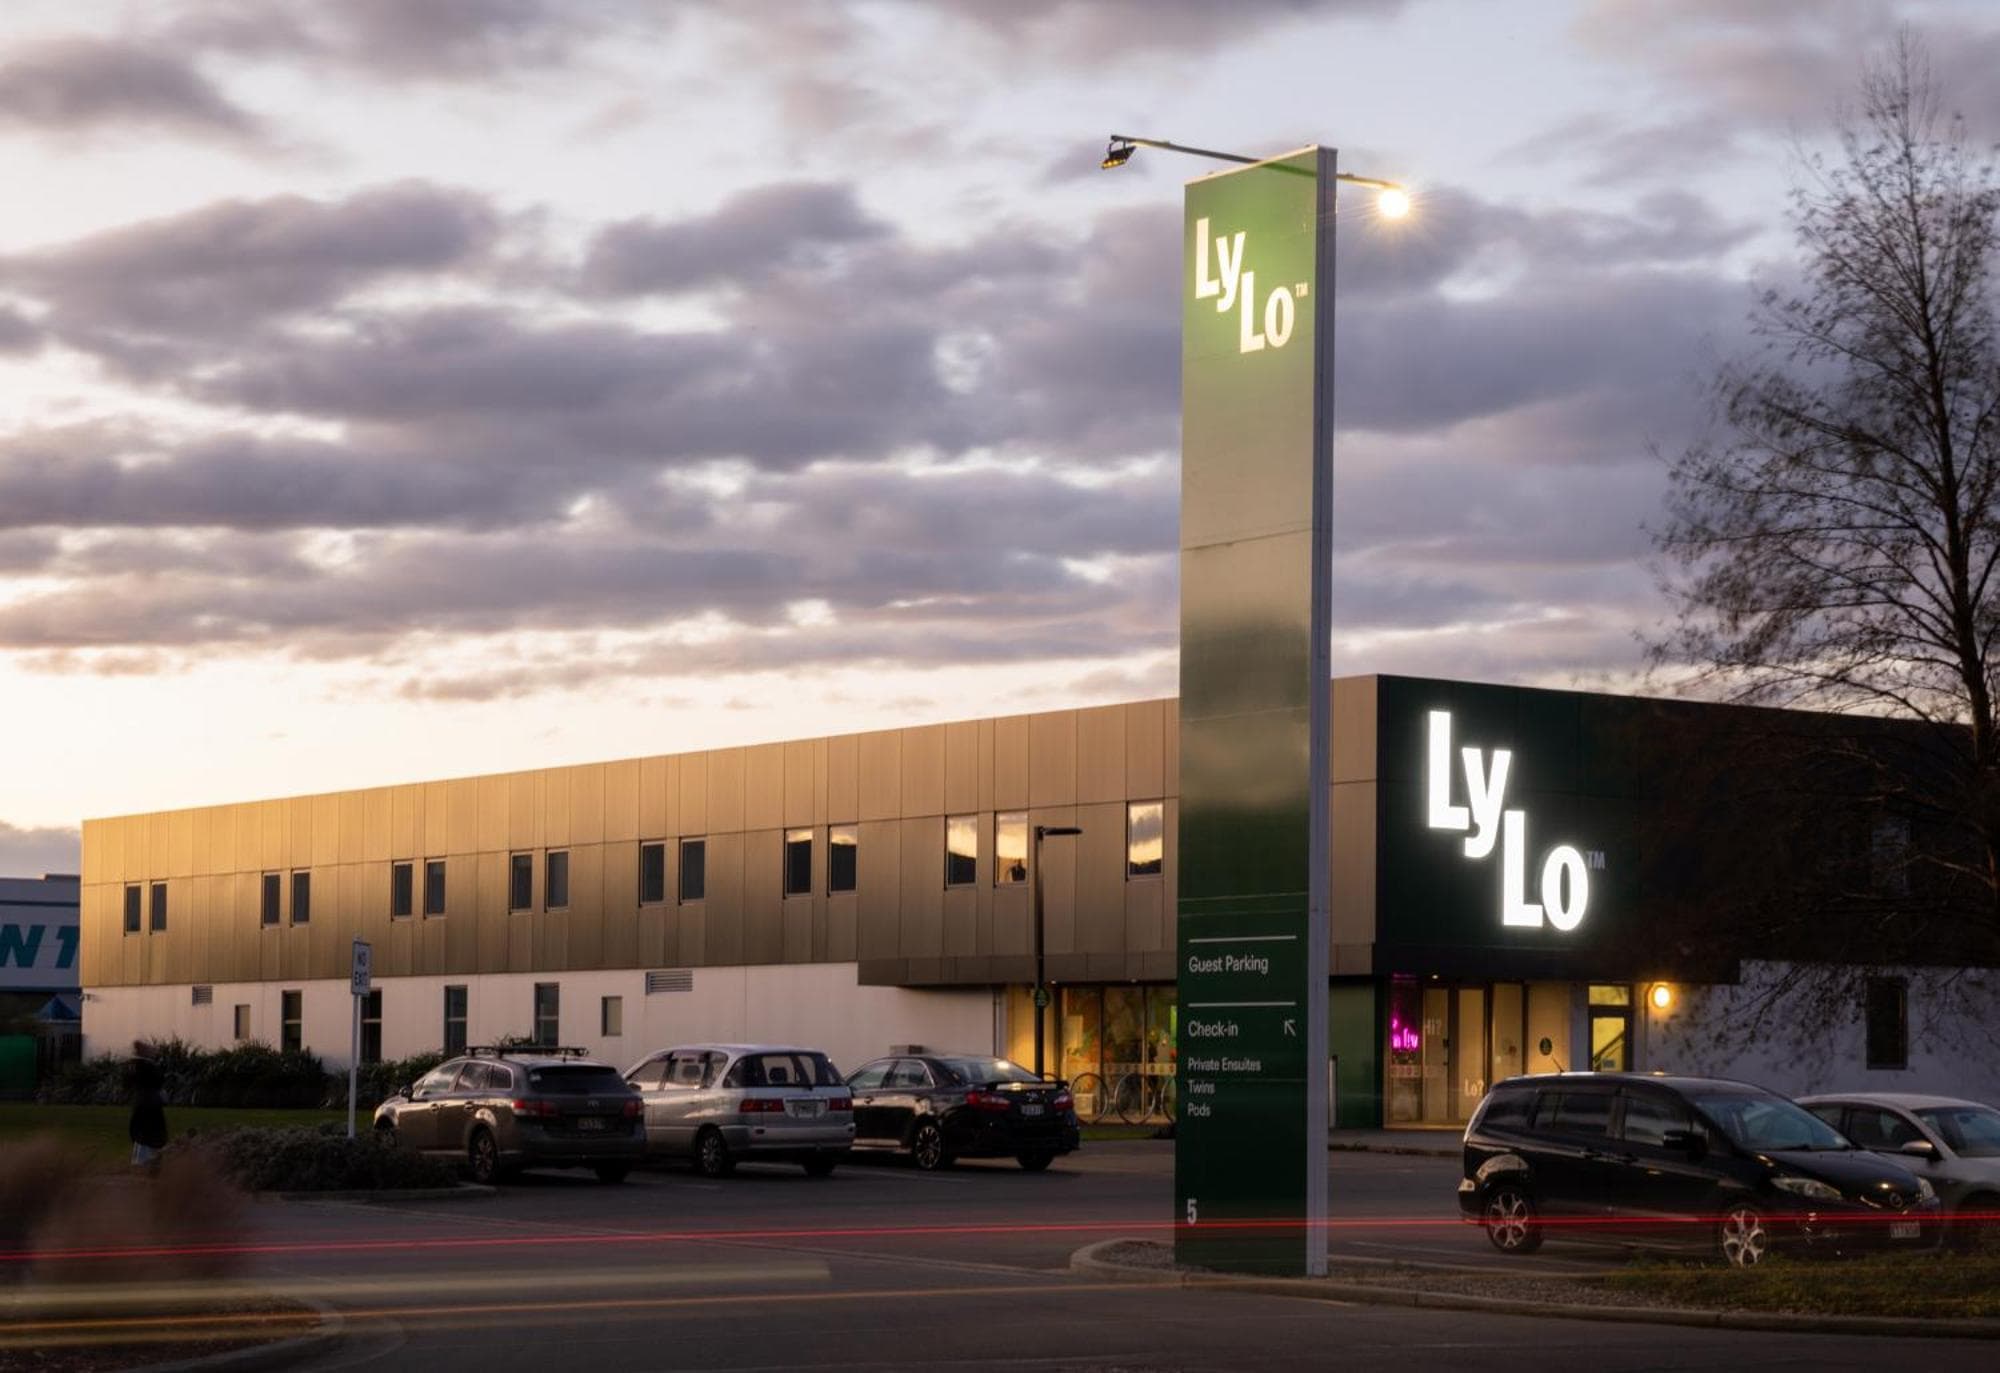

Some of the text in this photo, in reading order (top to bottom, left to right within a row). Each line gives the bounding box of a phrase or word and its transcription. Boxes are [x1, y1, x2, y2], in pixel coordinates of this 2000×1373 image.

[1188, 953, 1269, 975] Guest Parking
[1188, 1020, 1239, 1037] Check-in
[1187, 1056, 1262, 1072] Private Ensuites
[1188, 1079, 1216, 1094] Twins
[1187, 1102, 1211, 1117] Pods
[1186, 1198, 1198, 1225] 5
